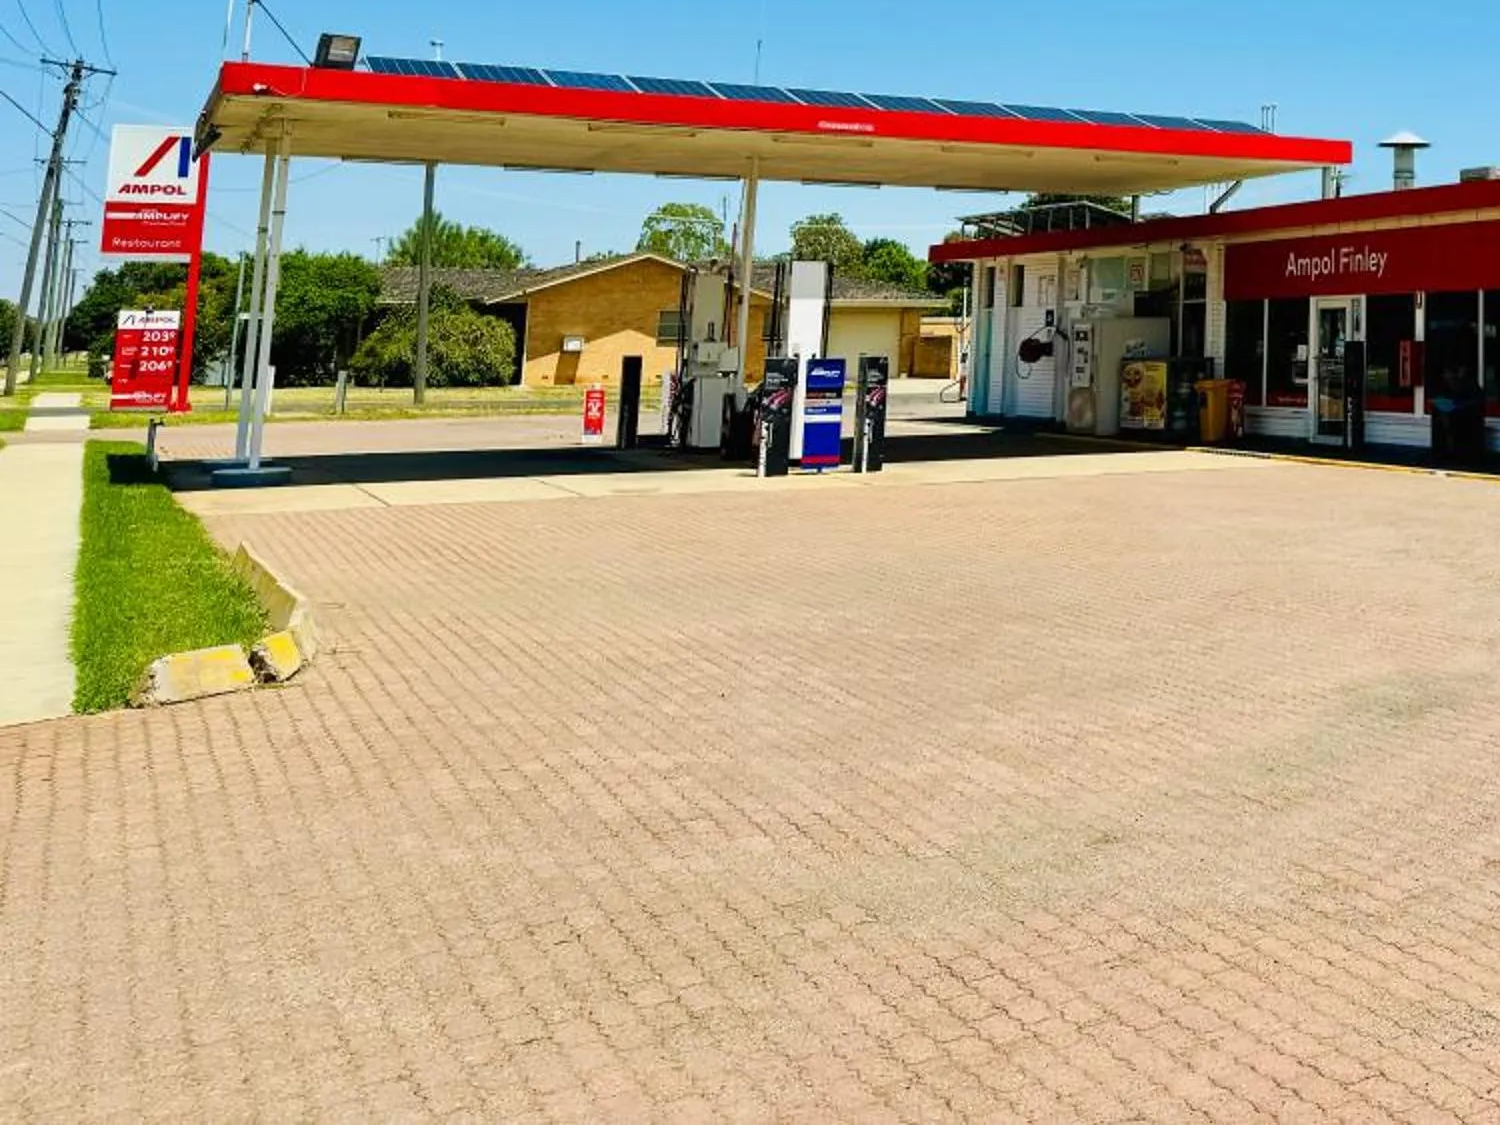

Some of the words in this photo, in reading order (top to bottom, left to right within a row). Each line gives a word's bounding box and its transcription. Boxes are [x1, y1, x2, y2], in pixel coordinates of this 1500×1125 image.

[118, 183, 188, 196] AMPOL
[111, 236, 182, 249] Restaurant
[1285, 249, 1335, 282] Ampol
[1339, 246, 1389, 276] Finley
